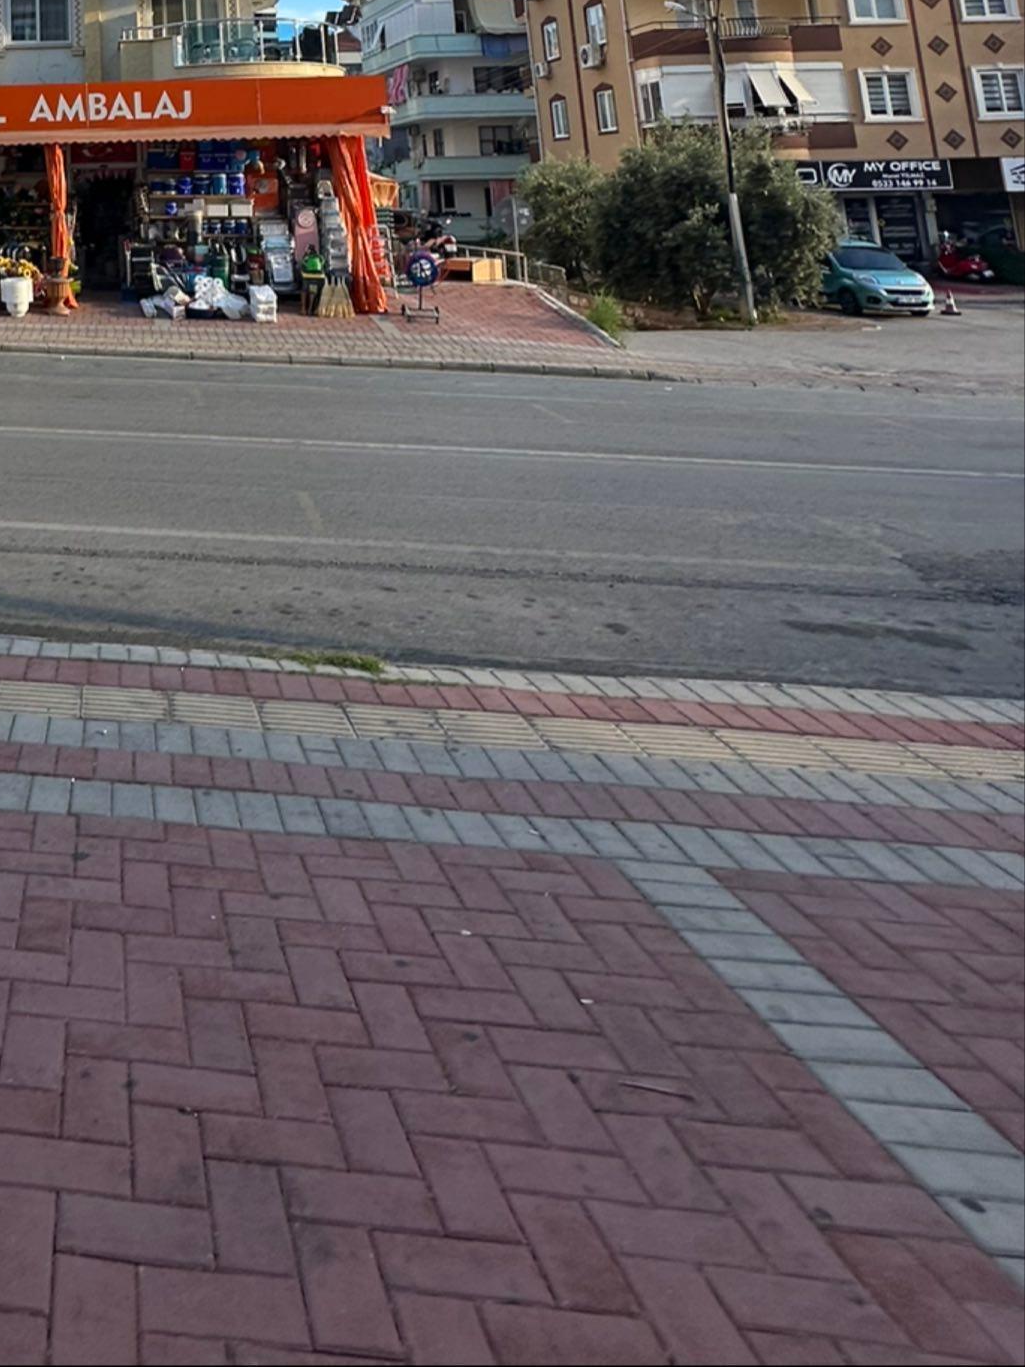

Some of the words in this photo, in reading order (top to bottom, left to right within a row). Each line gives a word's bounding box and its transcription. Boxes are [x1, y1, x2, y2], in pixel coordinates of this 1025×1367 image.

[30, 90, 193, 121] AMBALAJ
[863, 161, 885, 172] MY
[890, 159, 941, 172] OFFICE
